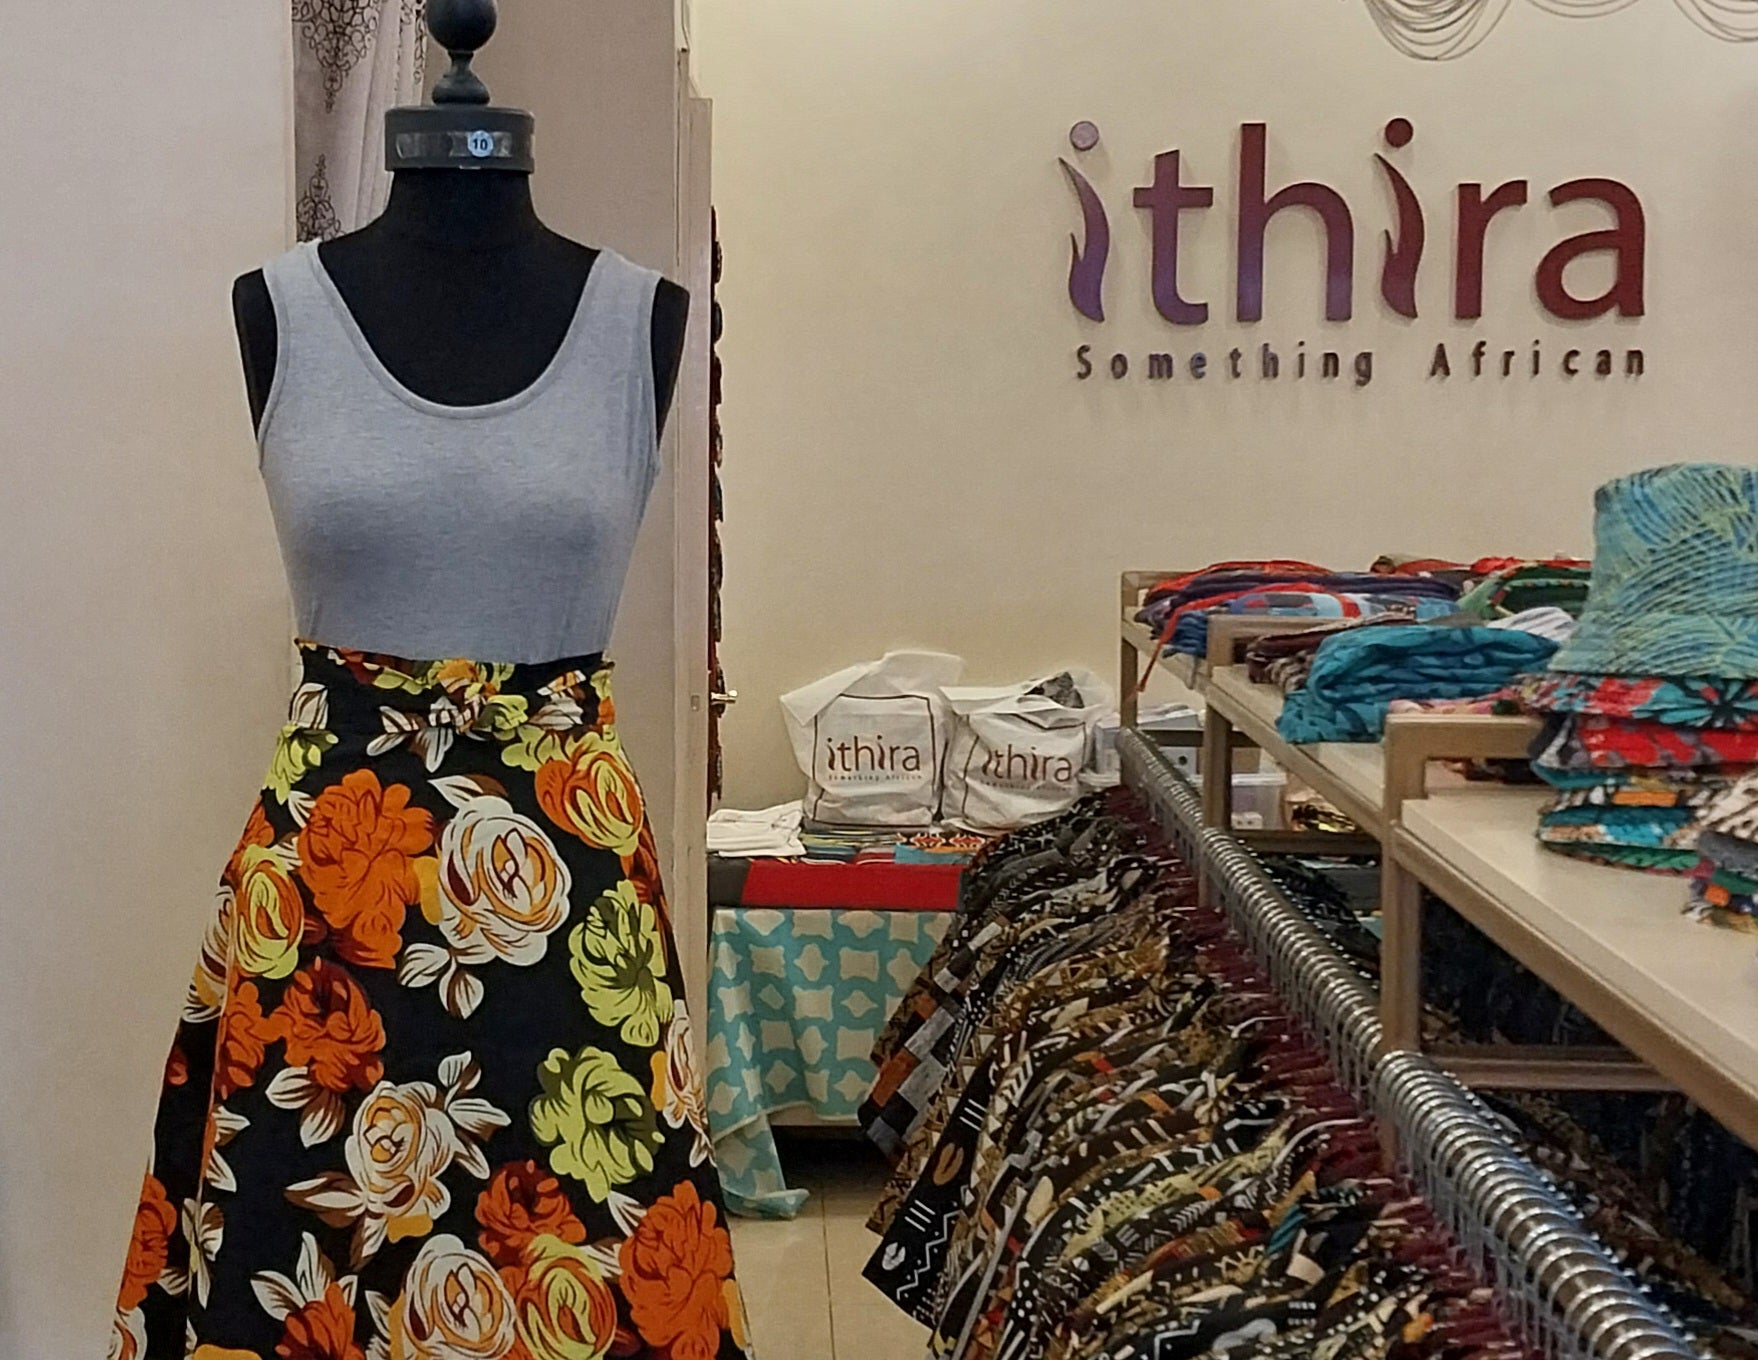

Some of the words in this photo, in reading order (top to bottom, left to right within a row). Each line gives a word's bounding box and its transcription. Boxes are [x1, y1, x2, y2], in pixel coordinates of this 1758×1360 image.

[472, 138, 489, 151] 10
[1058, 117, 1646, 325] ithira
[1076, 343, 1374, 387] Something
[1429, 341, 1645, 379] African
[826, 735, 920, 772] ithira
